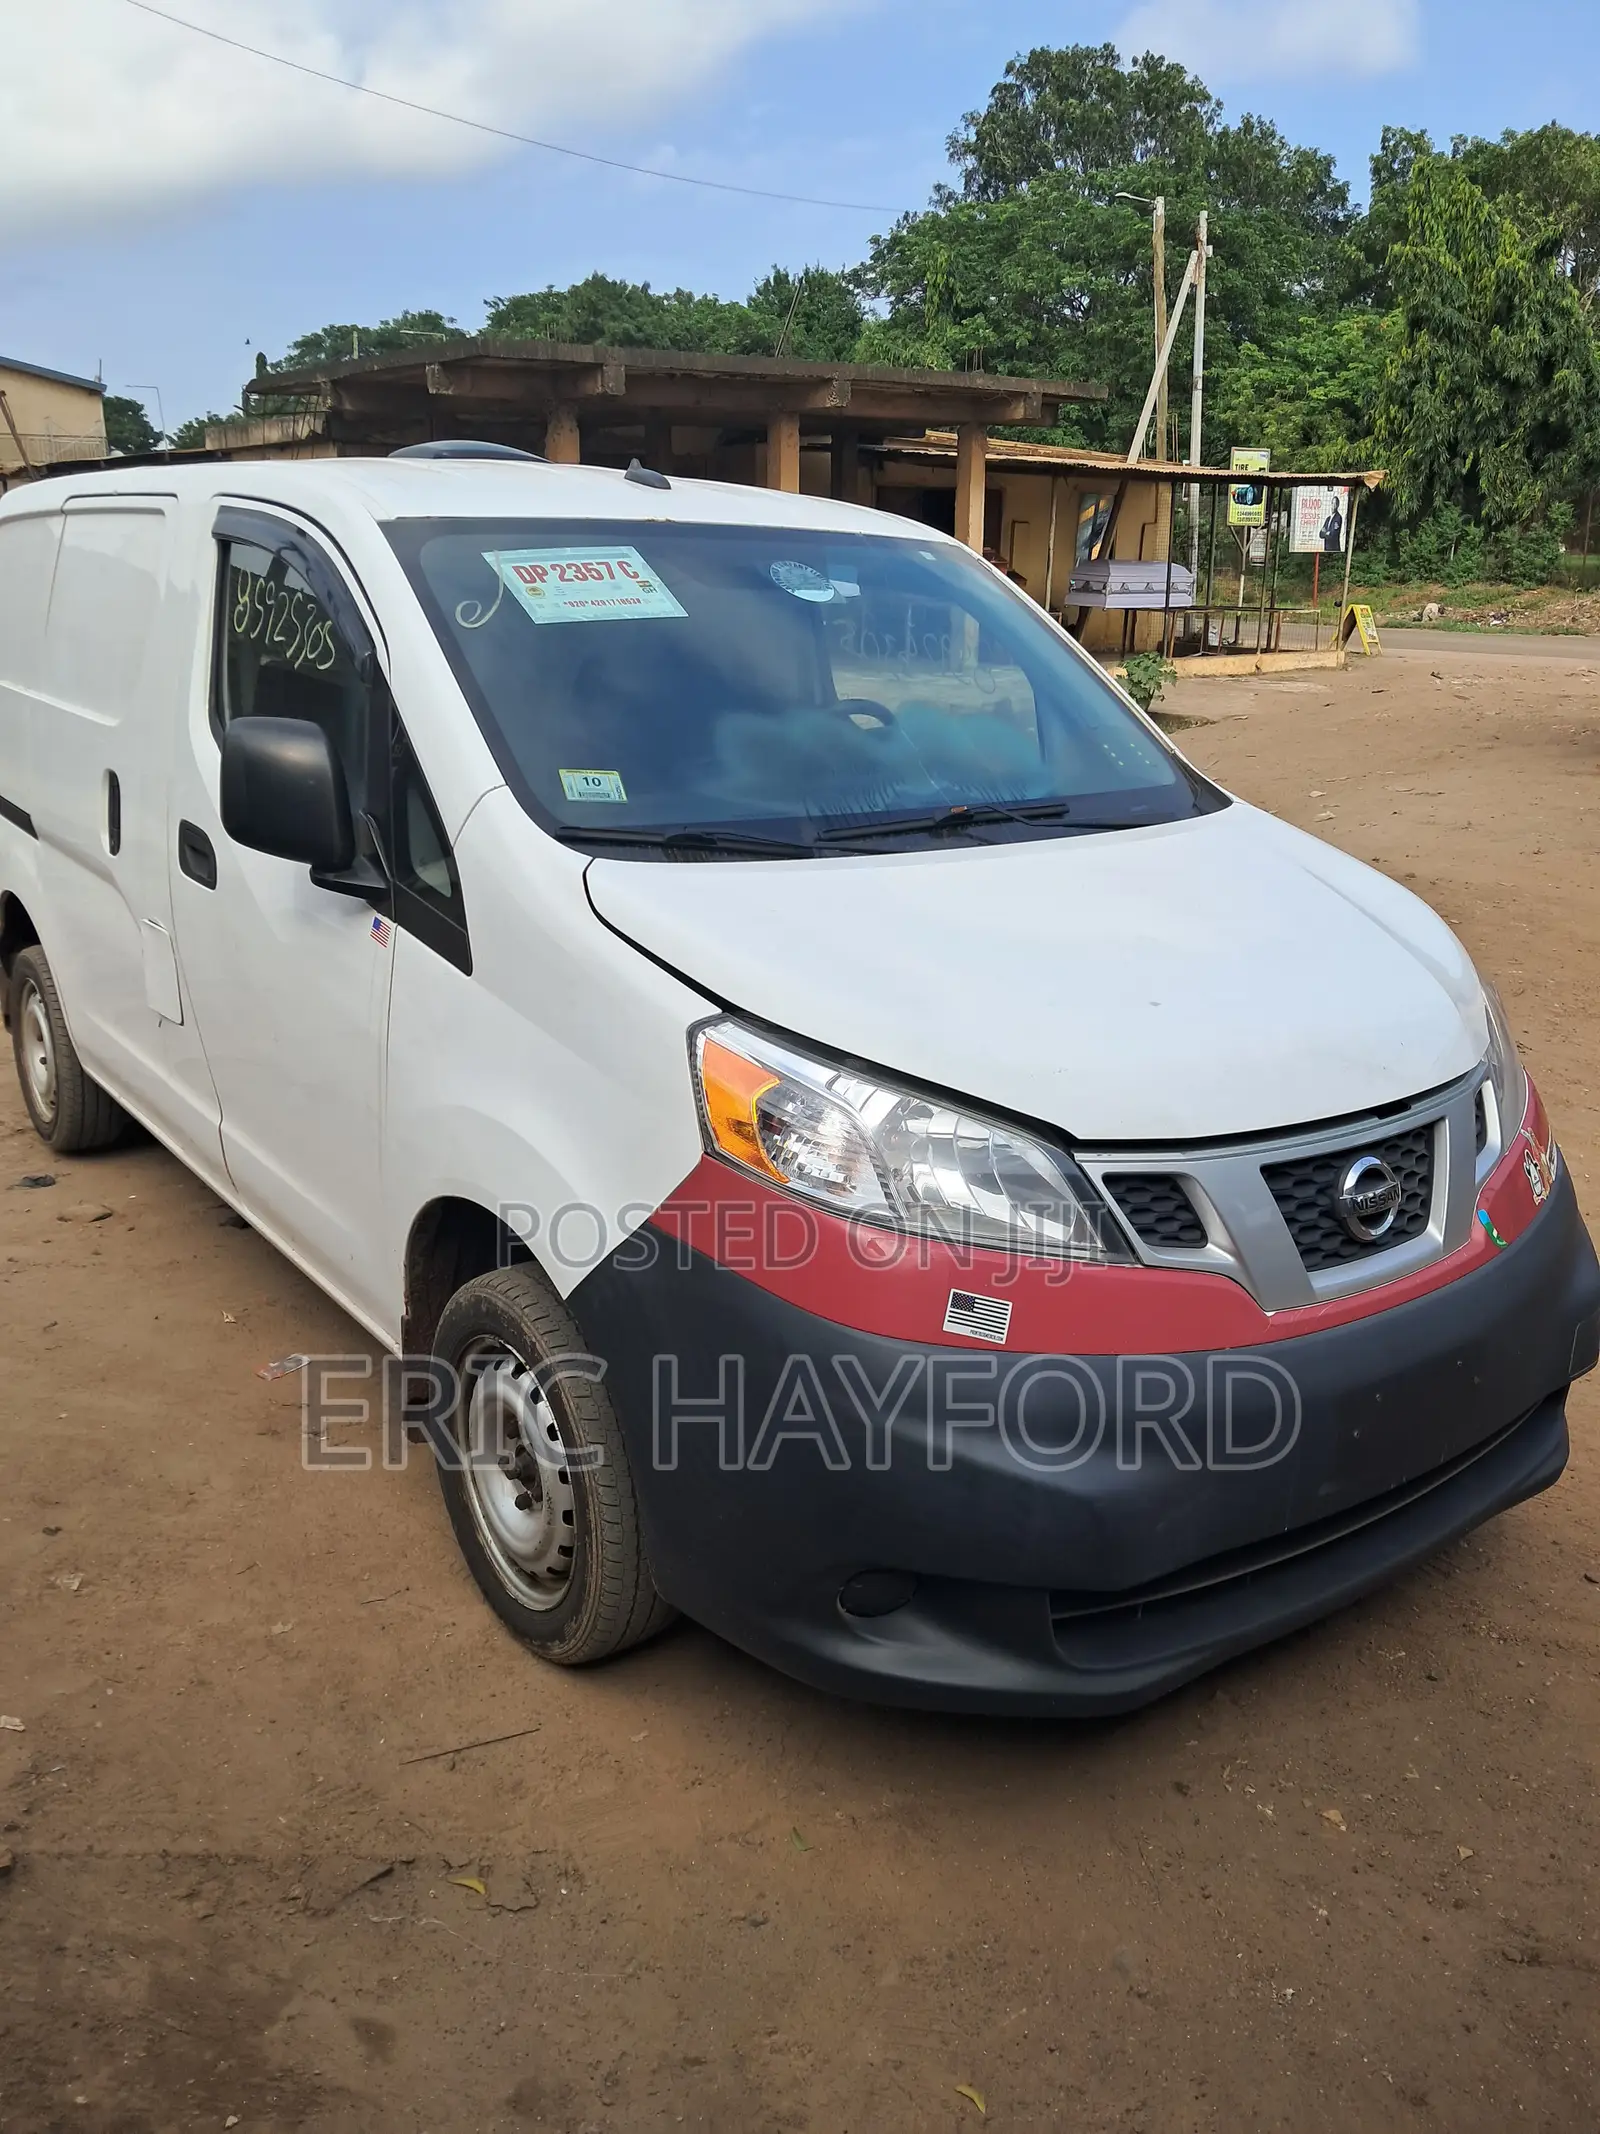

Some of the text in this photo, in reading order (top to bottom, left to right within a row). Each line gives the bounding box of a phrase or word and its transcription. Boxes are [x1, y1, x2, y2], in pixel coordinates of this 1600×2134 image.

[1234, 463, 1249, 471] TIRE
[511, 560, 640, 585] DP 2357 C
[641, 586, 658, 595] GH
[582, 776, 602, 787] 10
[1352, 1187, 1400, 1211] NISSAN
